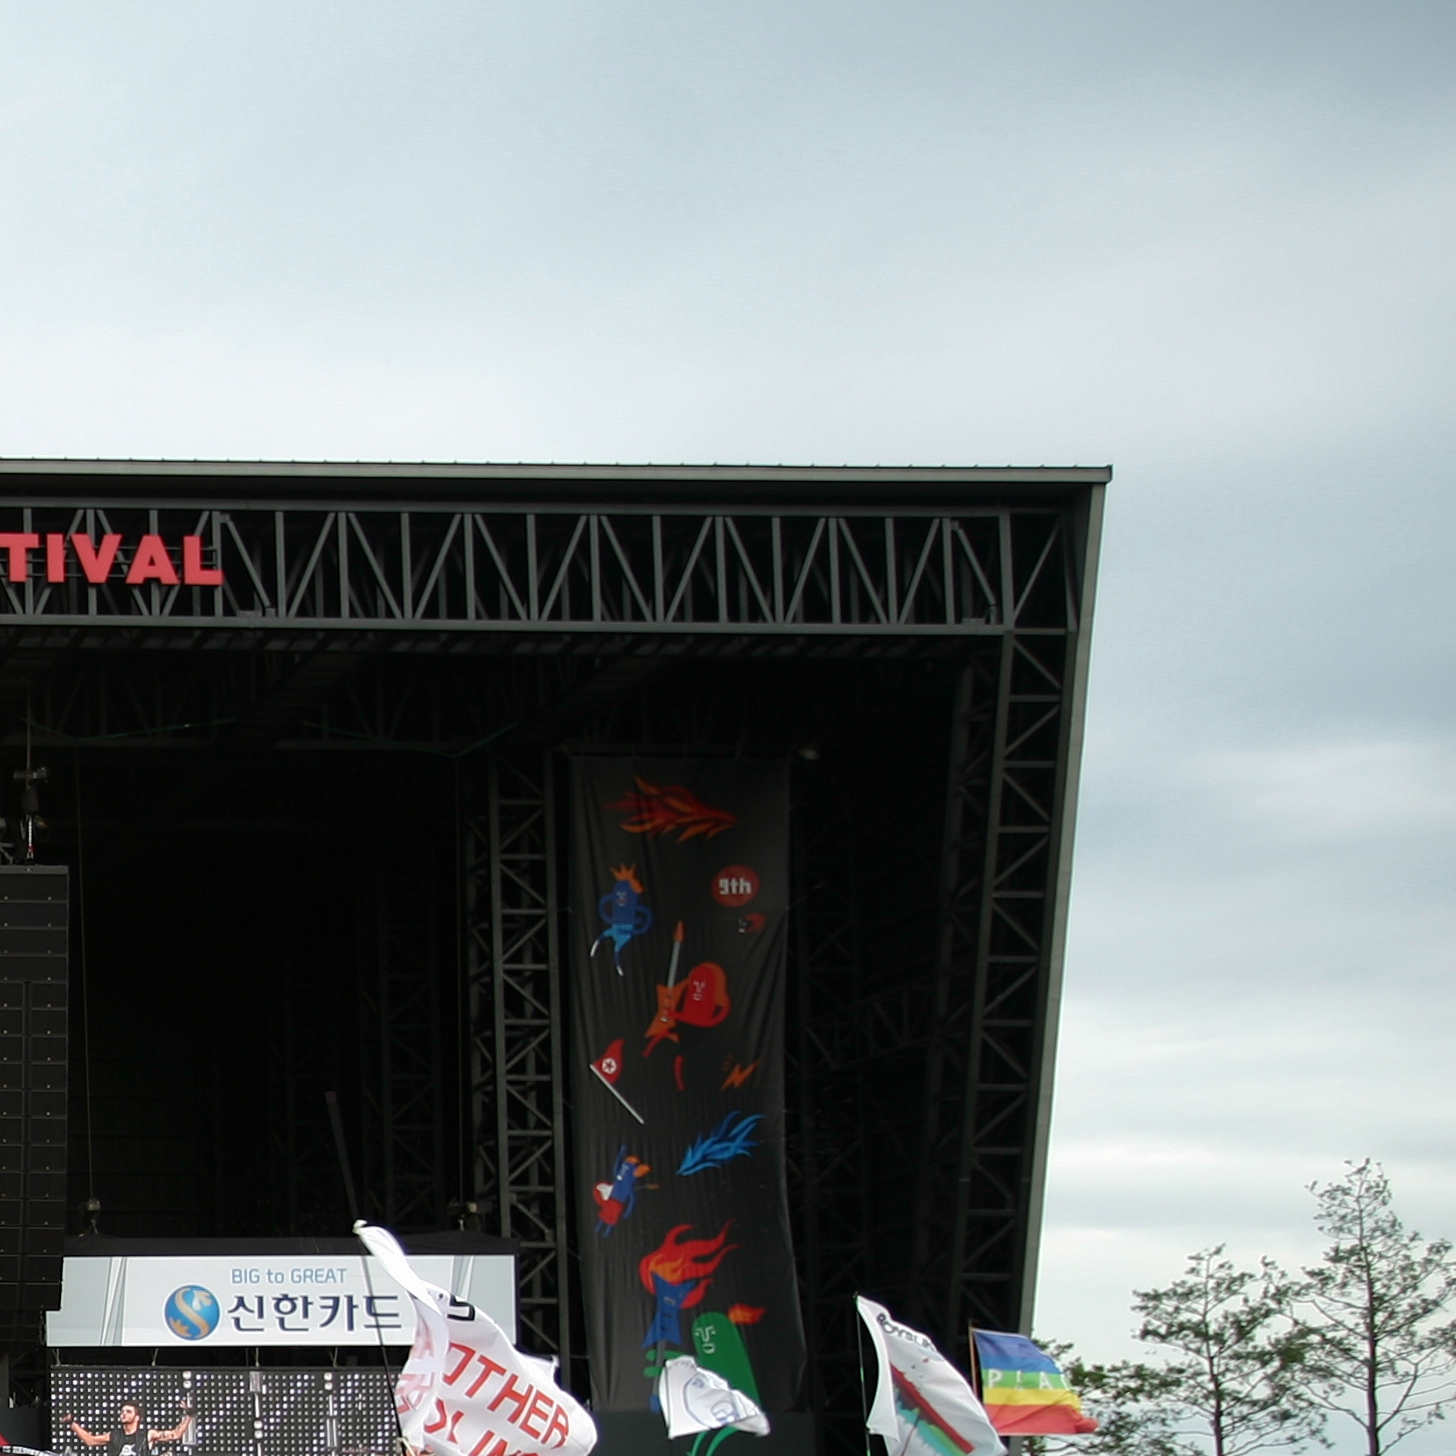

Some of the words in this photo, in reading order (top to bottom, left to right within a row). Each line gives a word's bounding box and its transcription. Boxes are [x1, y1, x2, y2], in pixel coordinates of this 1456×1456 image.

[718, 877, 752, 896] 9th
[231, 1268, 260, 1284] BIG
[266, 1268, 284, 1284] to
[290, 1268, 347, 1284] GREAT
[227, 1293, 402, 1332] 신한카드
